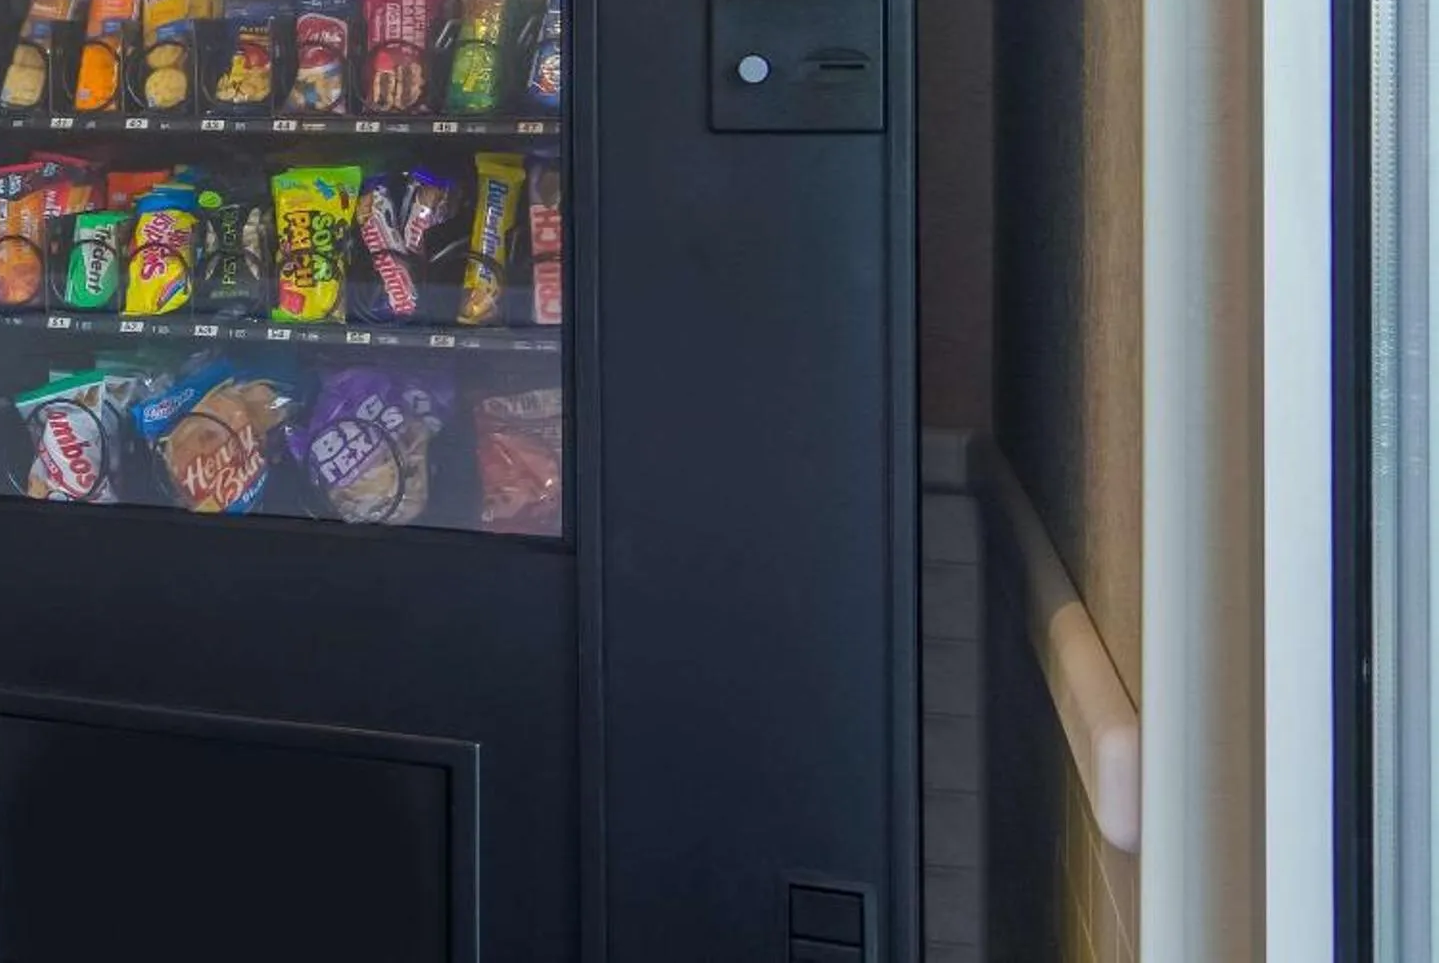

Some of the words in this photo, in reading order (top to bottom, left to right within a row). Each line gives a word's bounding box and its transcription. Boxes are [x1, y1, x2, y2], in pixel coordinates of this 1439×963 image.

[85, 224, 114, 295] Trident
[312, 213, 333, 282] SOUR
[478, 178, 508, 282] Butterfiner
[47, 411, 97, 489] ombos
[183, 425, 258, 496] Honey
[213, 451, 264, 504] Bun
